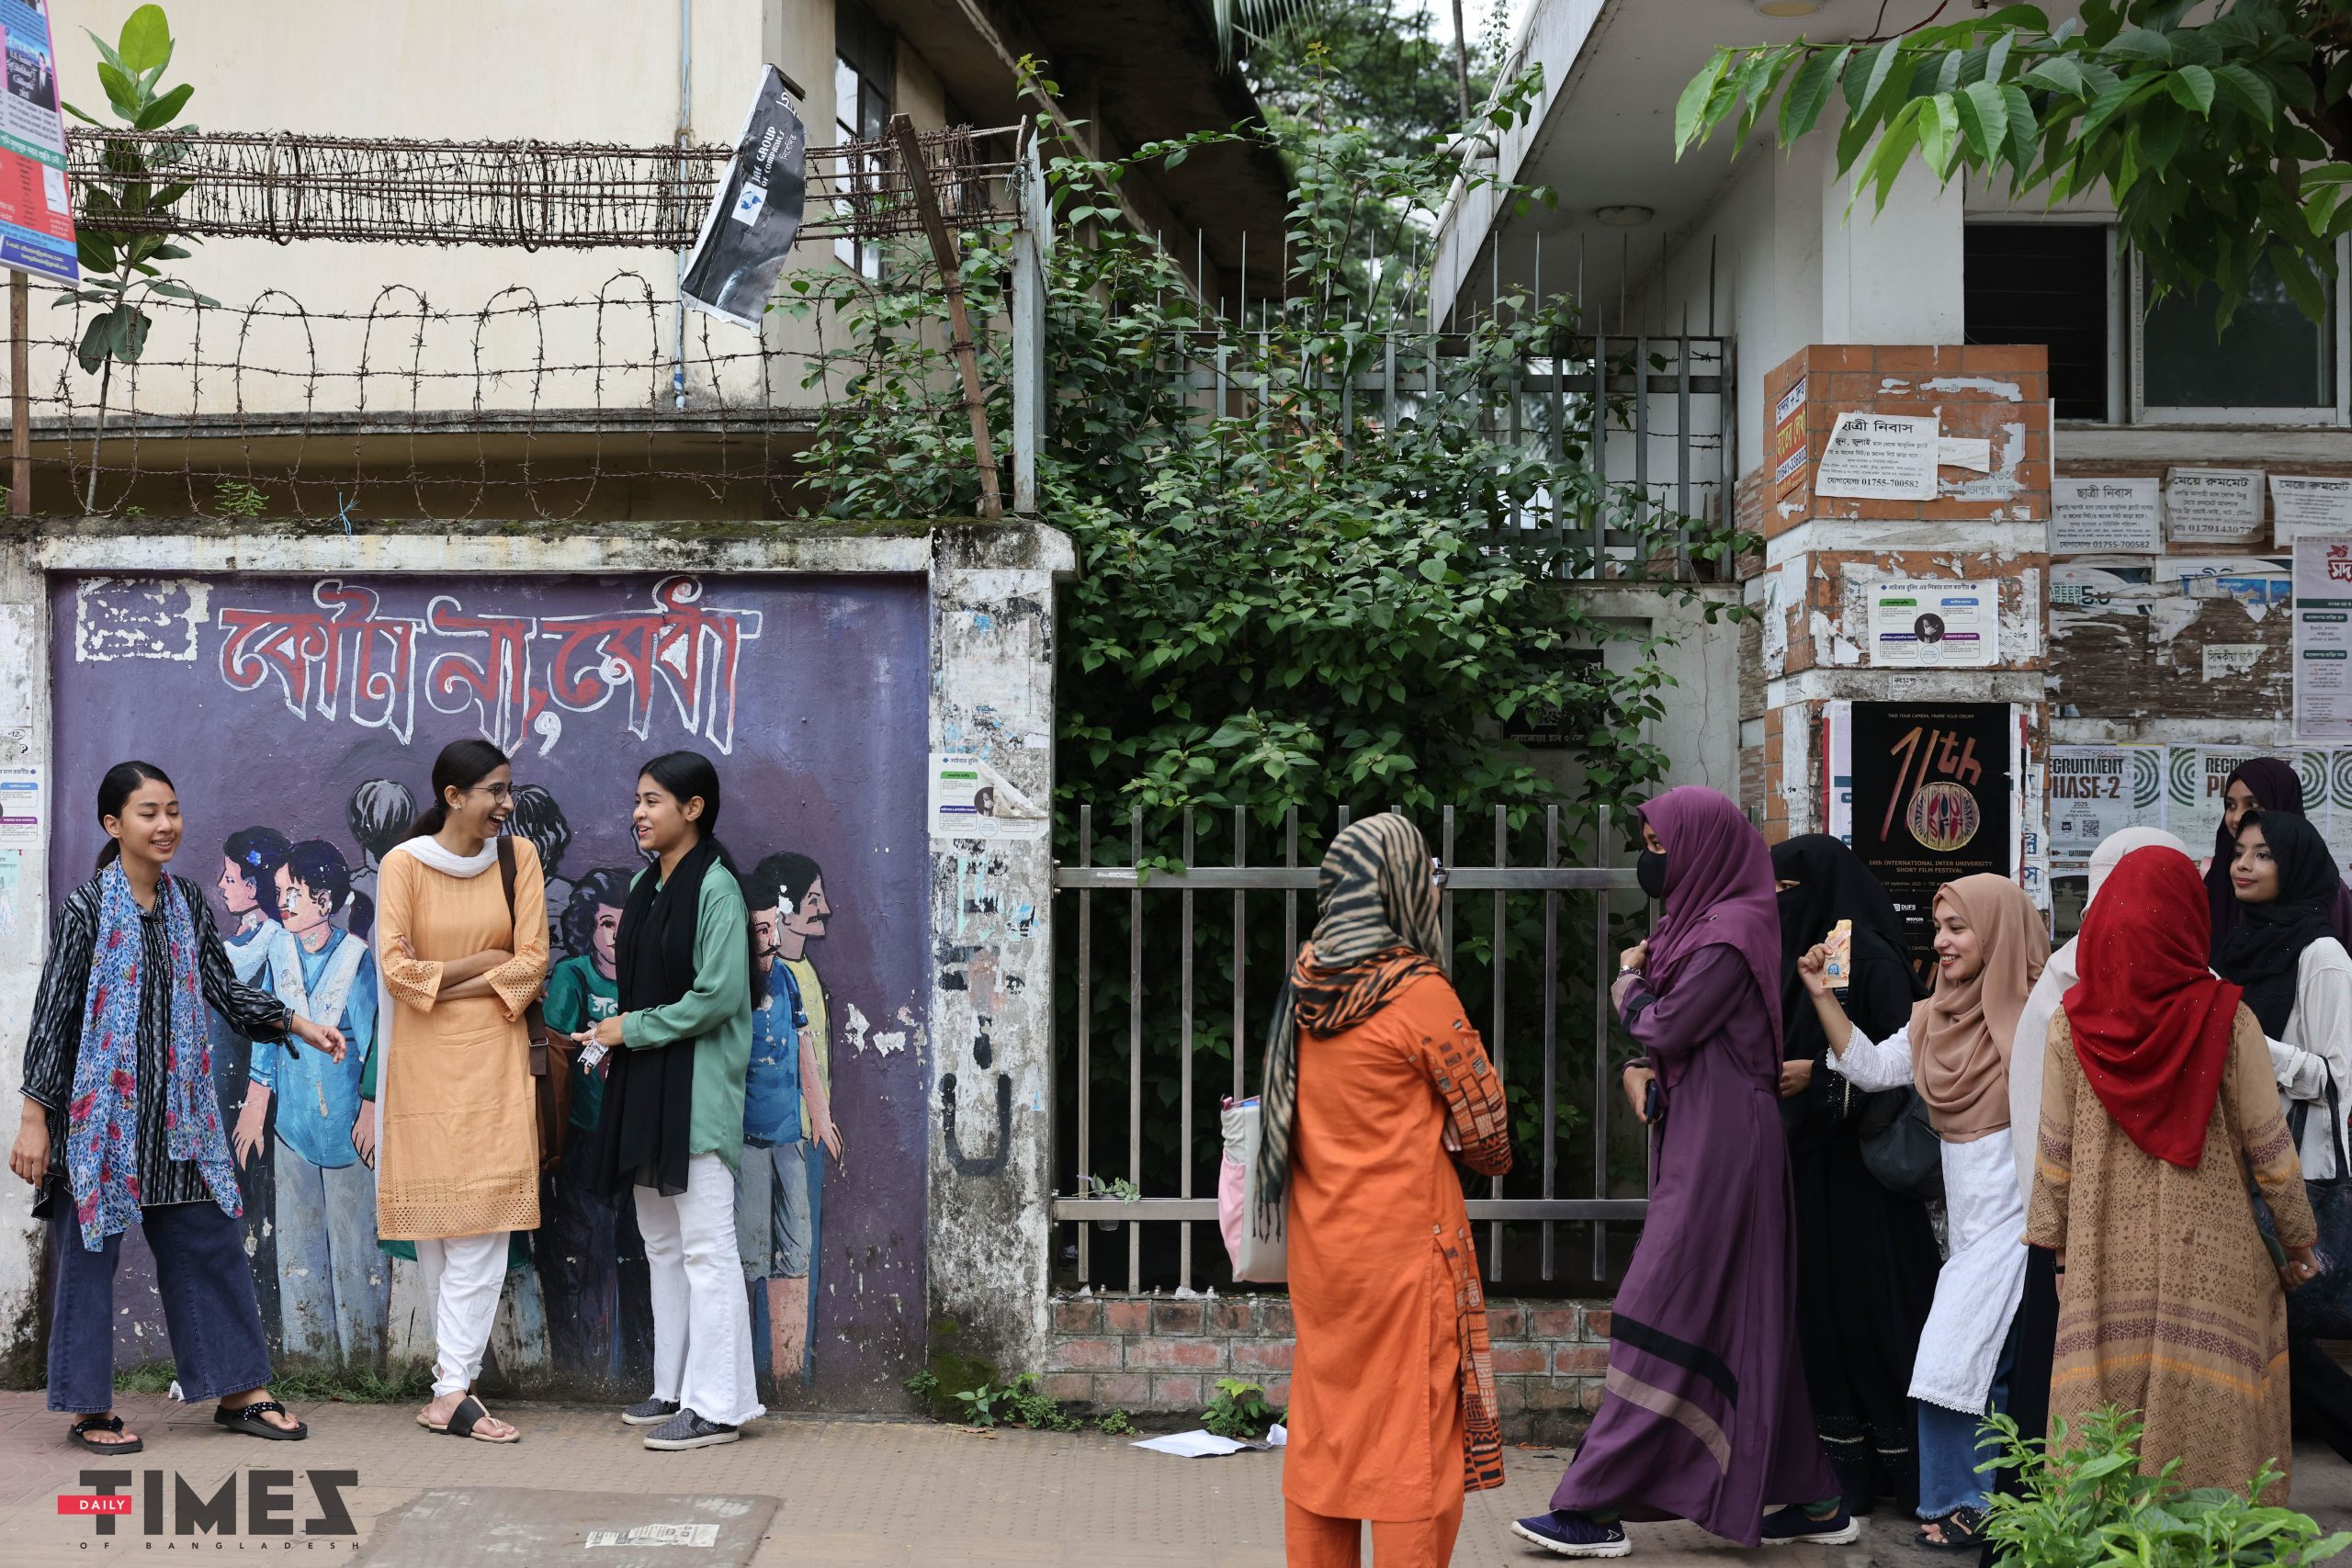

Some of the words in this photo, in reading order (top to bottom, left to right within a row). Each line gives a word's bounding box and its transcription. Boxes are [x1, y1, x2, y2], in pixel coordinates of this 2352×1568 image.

[756, 126, 776, 162] GROUP
[762, 175, 769, 186] OF
[1872, 420, 1915, 434] নিবাস
[1861, 478, 1919, 488] 01755-700582
[2205, 476, 2250, 487] রুমমেট
[2308, 479, 2351, 491] রুমমেট
[2076, 484, 2100, 500] ছাত্রী
[2102, 484, 2133, 499] নিবাস
[2093, 540, 2150, 548] 01755-700582
[2050, 585, 2081, 596] AREER
[967, 756, 979, 765] বুলি
[2049, 758, 2124, 774] ECRUITMENT
